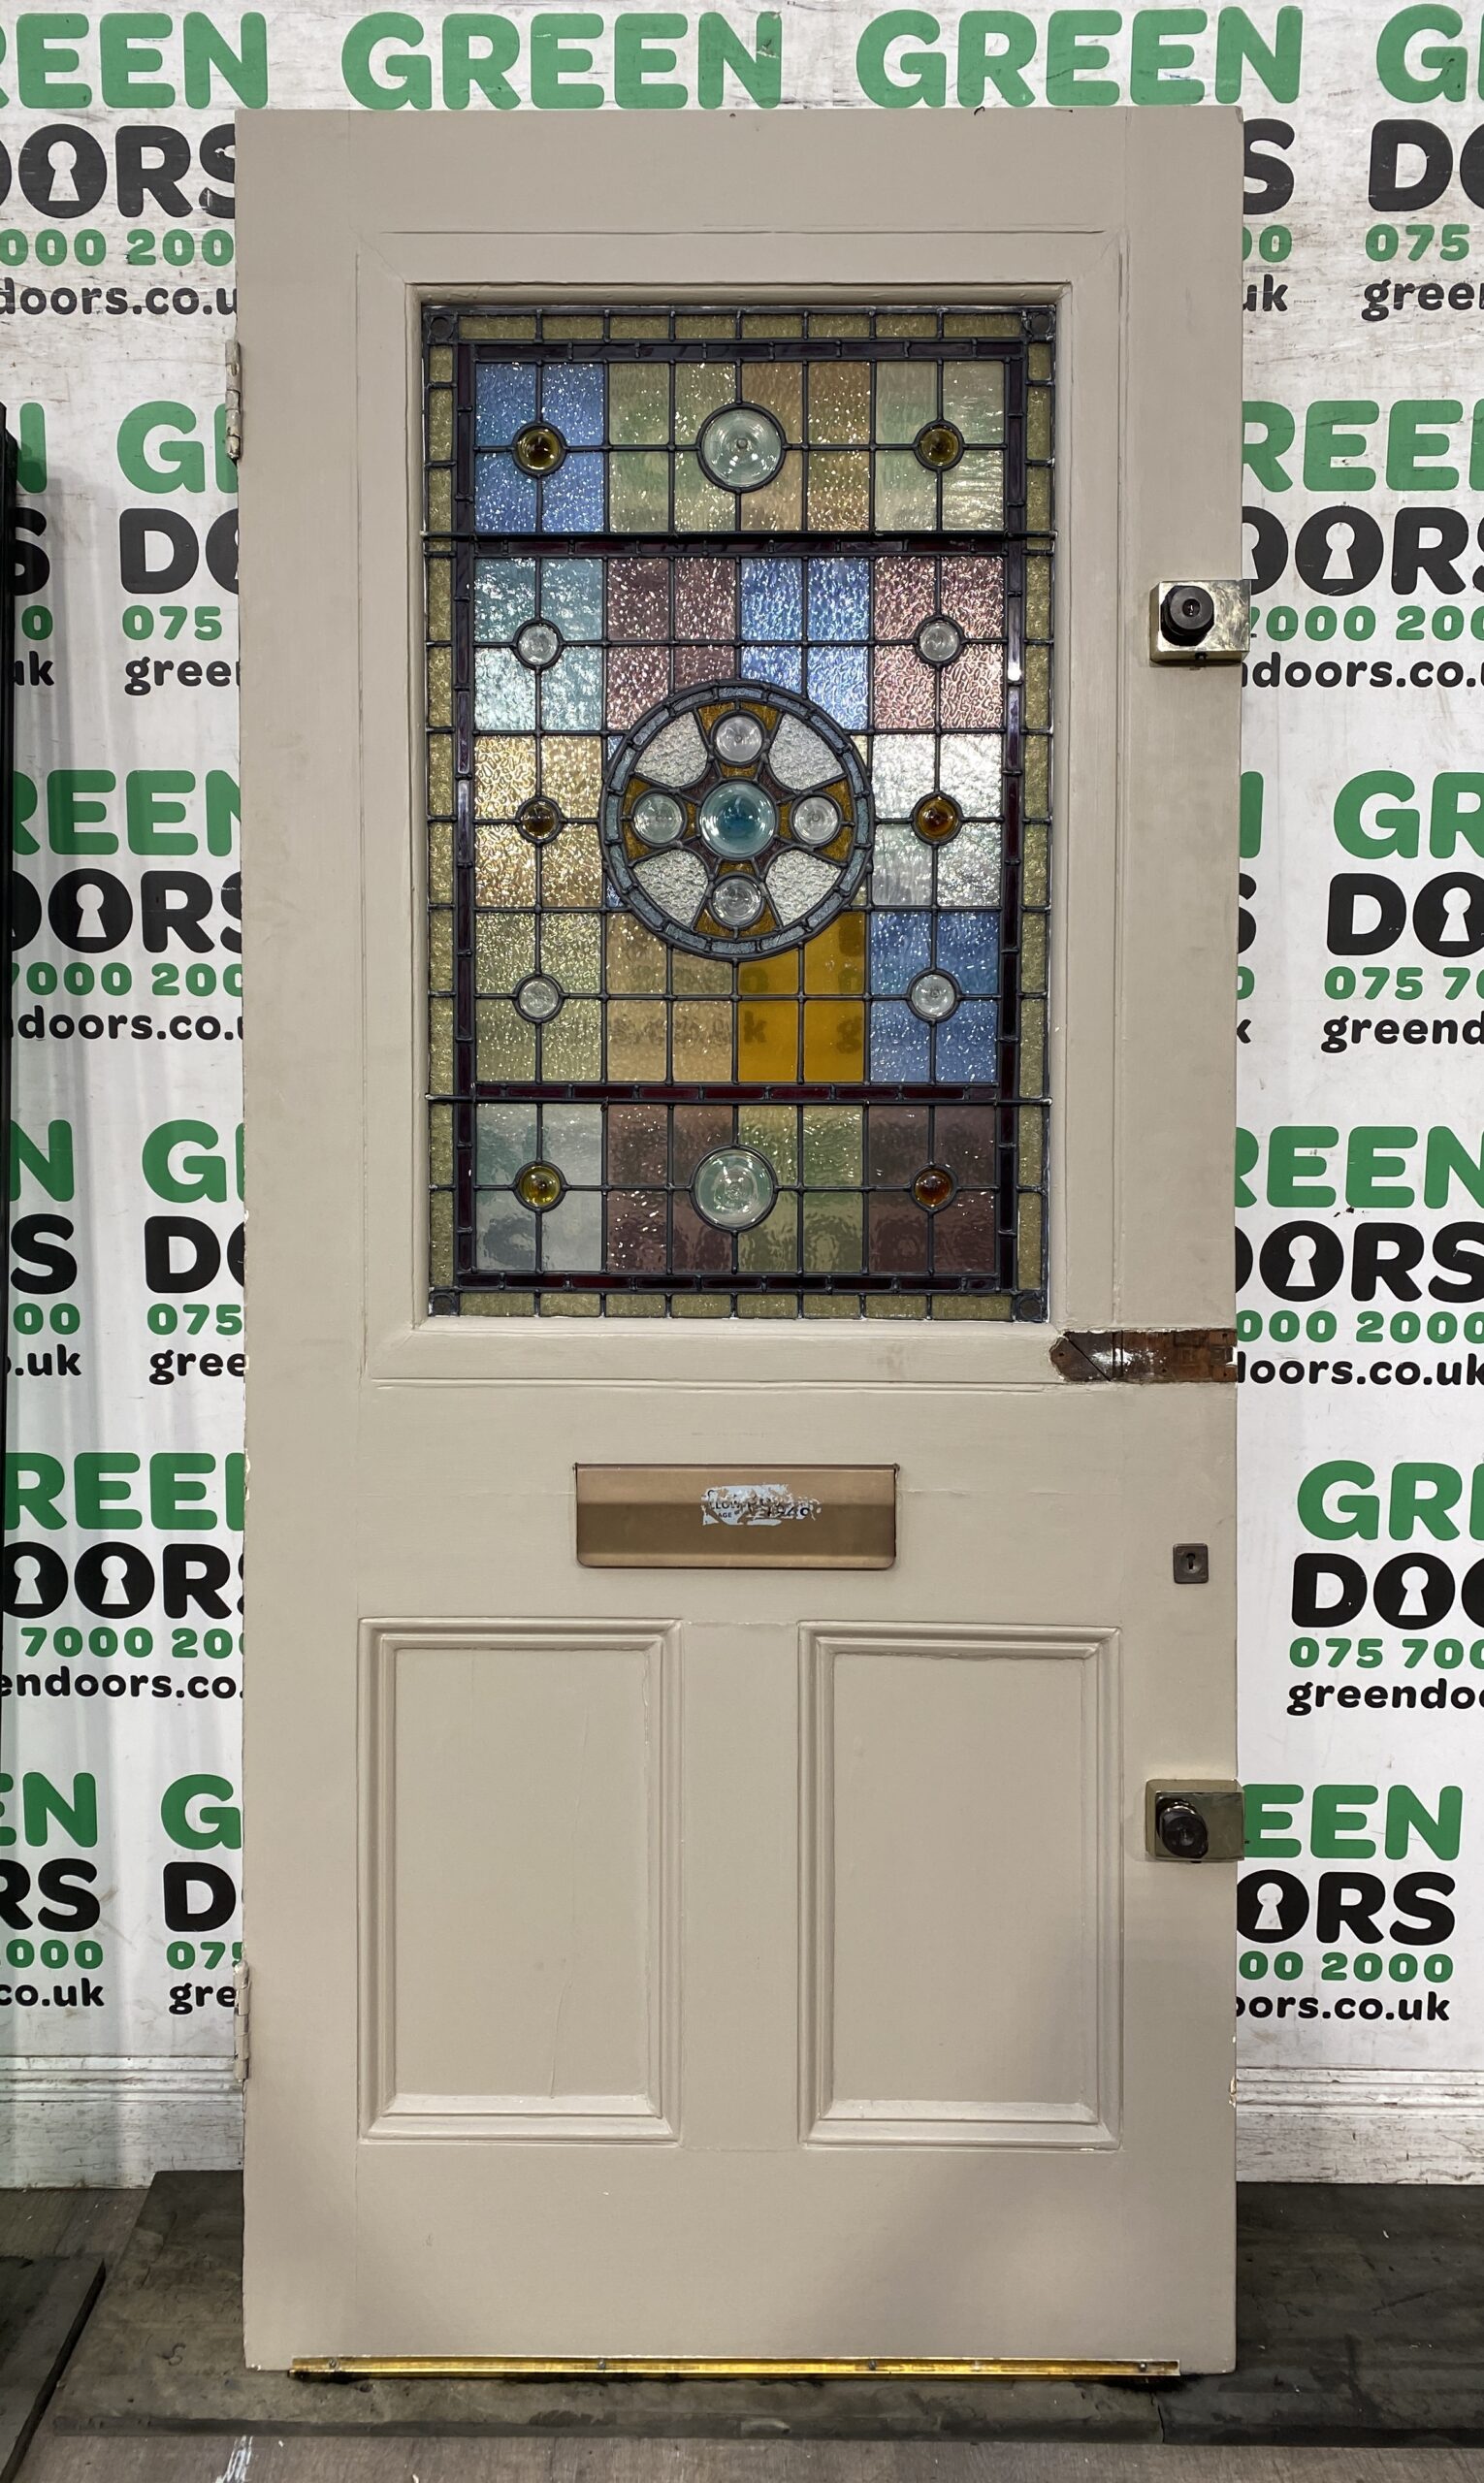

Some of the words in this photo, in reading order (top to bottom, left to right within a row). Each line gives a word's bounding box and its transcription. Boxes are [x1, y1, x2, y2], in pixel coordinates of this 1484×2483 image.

[342, 12, 782, 109] GREEN
[856, 6, 1303, 107] GREEN
[126, 229, 234, 266] 200
[1366, 224, 1469, 262] 075
[122, 605, 222, 640] 075
[1325, 967, 1423, 1000] 075
[11, 1213, 78, 1295] S
[13, 1303, 81, 1335] 00
[147, 1304, 242, 1335] 075
[21, 1627, 153, 1658] 7000
[1290, 1637, 1382, 1668] 075
[1321, 1952, 1453, 1983] 2000
